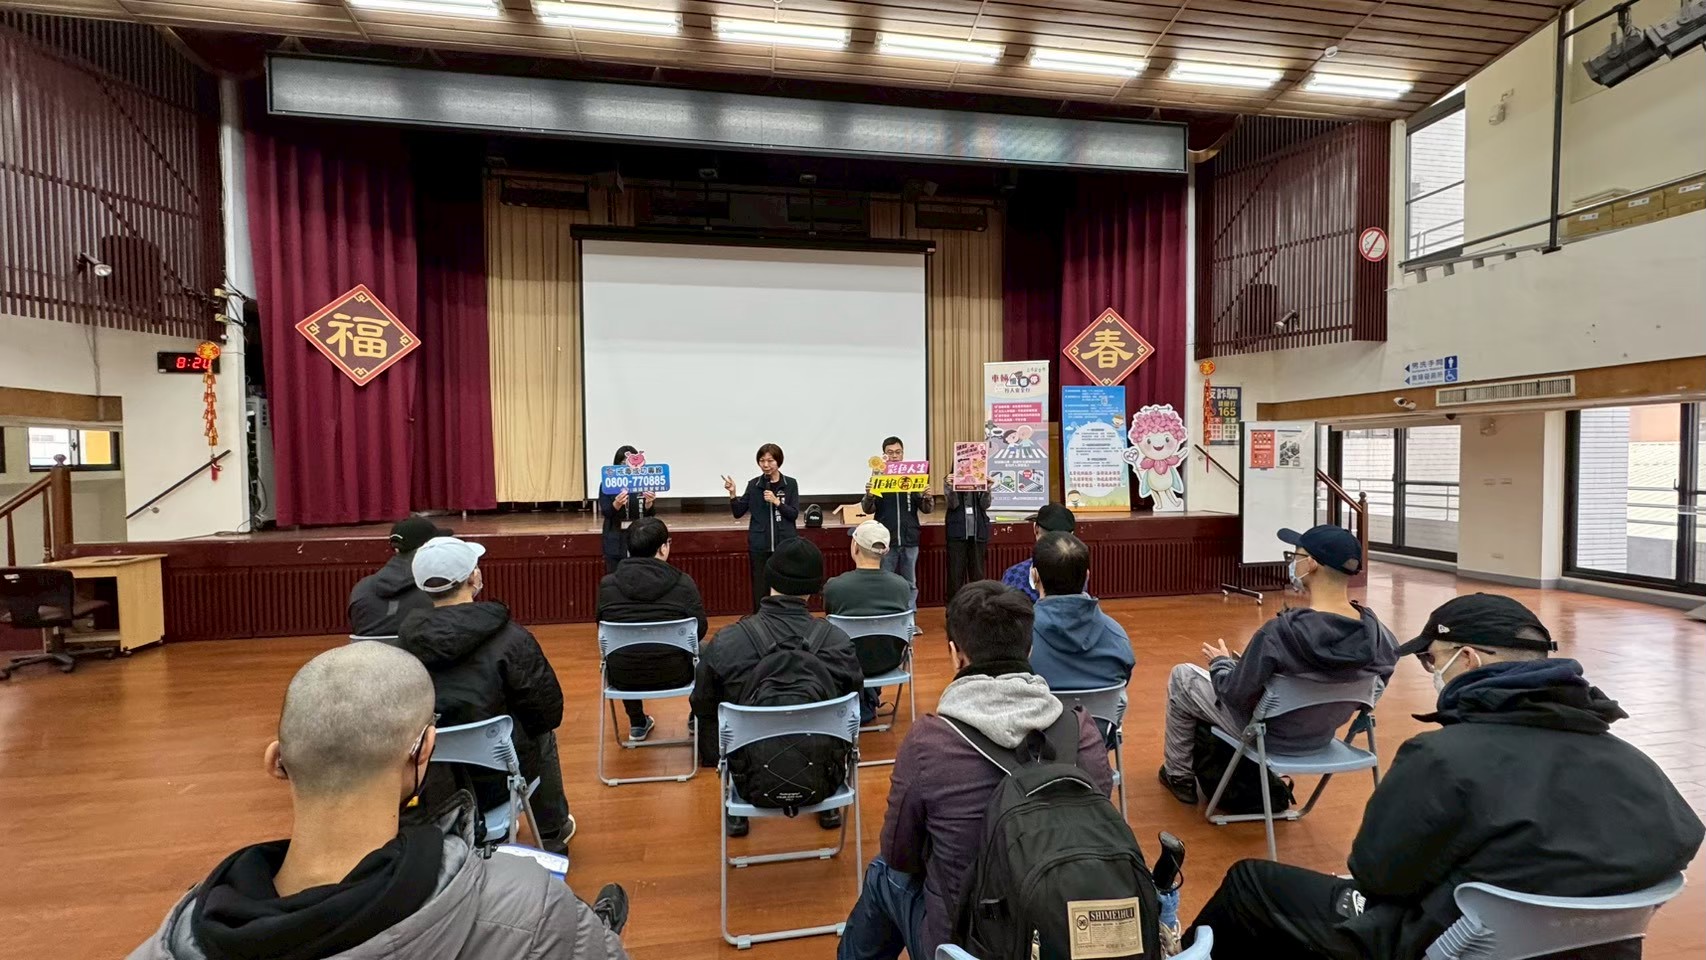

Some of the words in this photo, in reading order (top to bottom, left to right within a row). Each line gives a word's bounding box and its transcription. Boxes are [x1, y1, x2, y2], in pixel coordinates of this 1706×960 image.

[325, 312, 391, 359] 福
[1080, 328, 1134, 369] 春
[1218, 407, 1237, 417] 165
[887, 463, 926, 474] 彩色人生
[605, 475, 666, 488] 0800-770885
[1090, 908, 1133, 921] SHIMEIHUI
